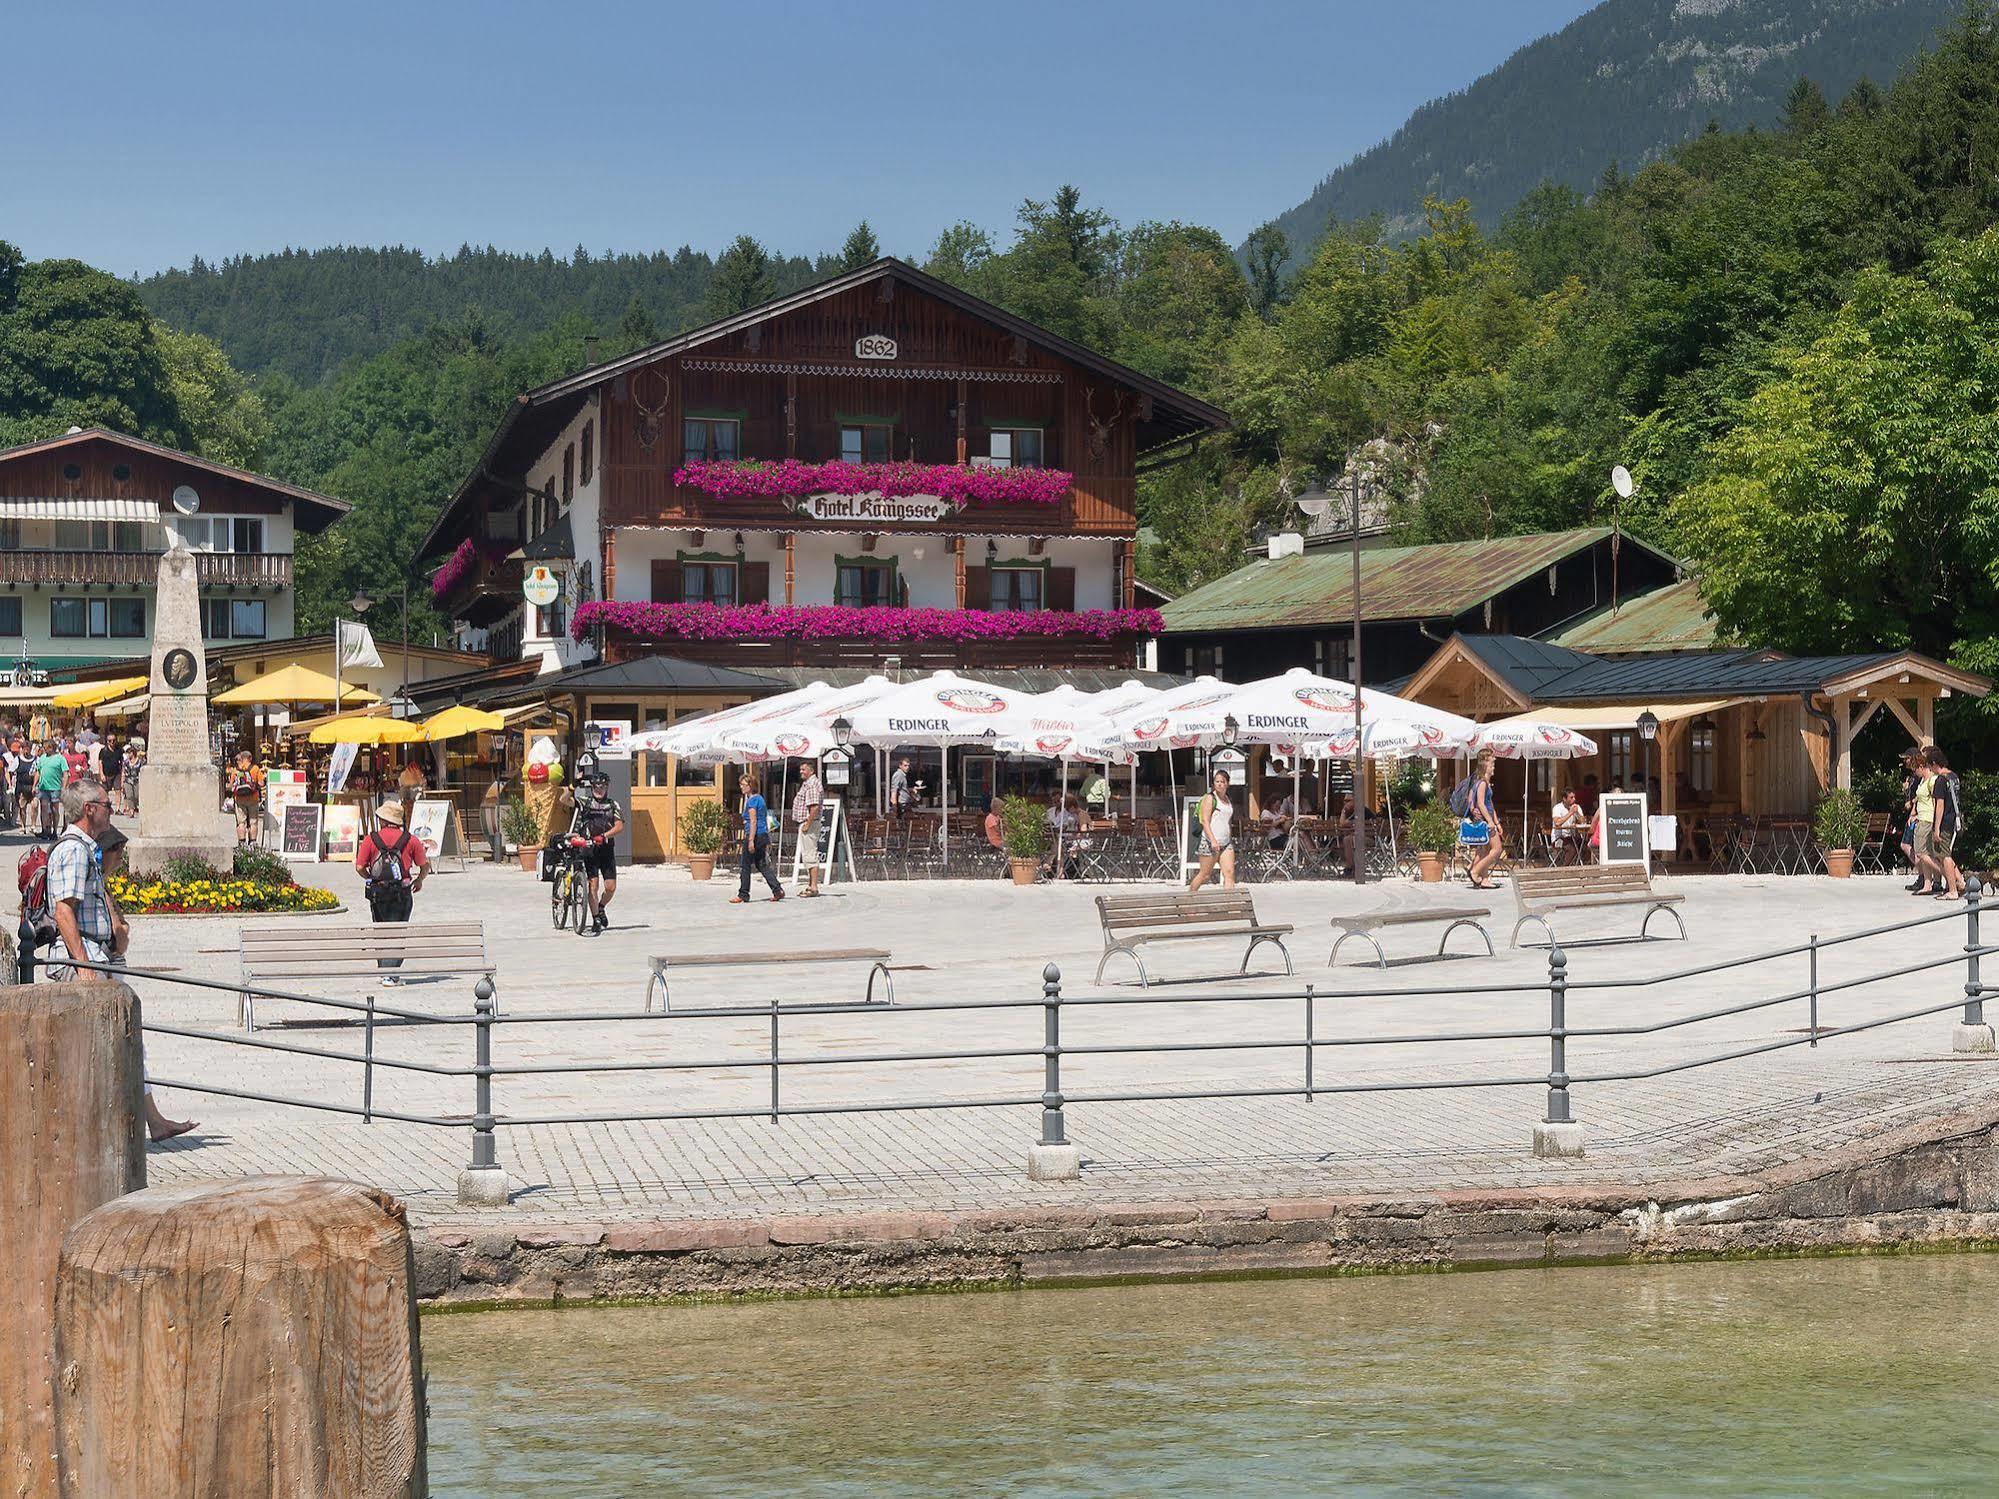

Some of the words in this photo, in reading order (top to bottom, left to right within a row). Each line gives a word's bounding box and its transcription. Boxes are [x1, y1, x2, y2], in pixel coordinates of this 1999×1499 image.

[858, 339, 895, 357] 1862
[815, 497, 854, 519] Hotel
[856, 497, 938, 521] Königssee
[889, 718, 950, 732] ERDINGER
[1247, 714, 1309, 729] ERDINGER
[1373, 737, 1408, 750] ERDINGER
[1491, 733, 1524, 742] ERDINGER
